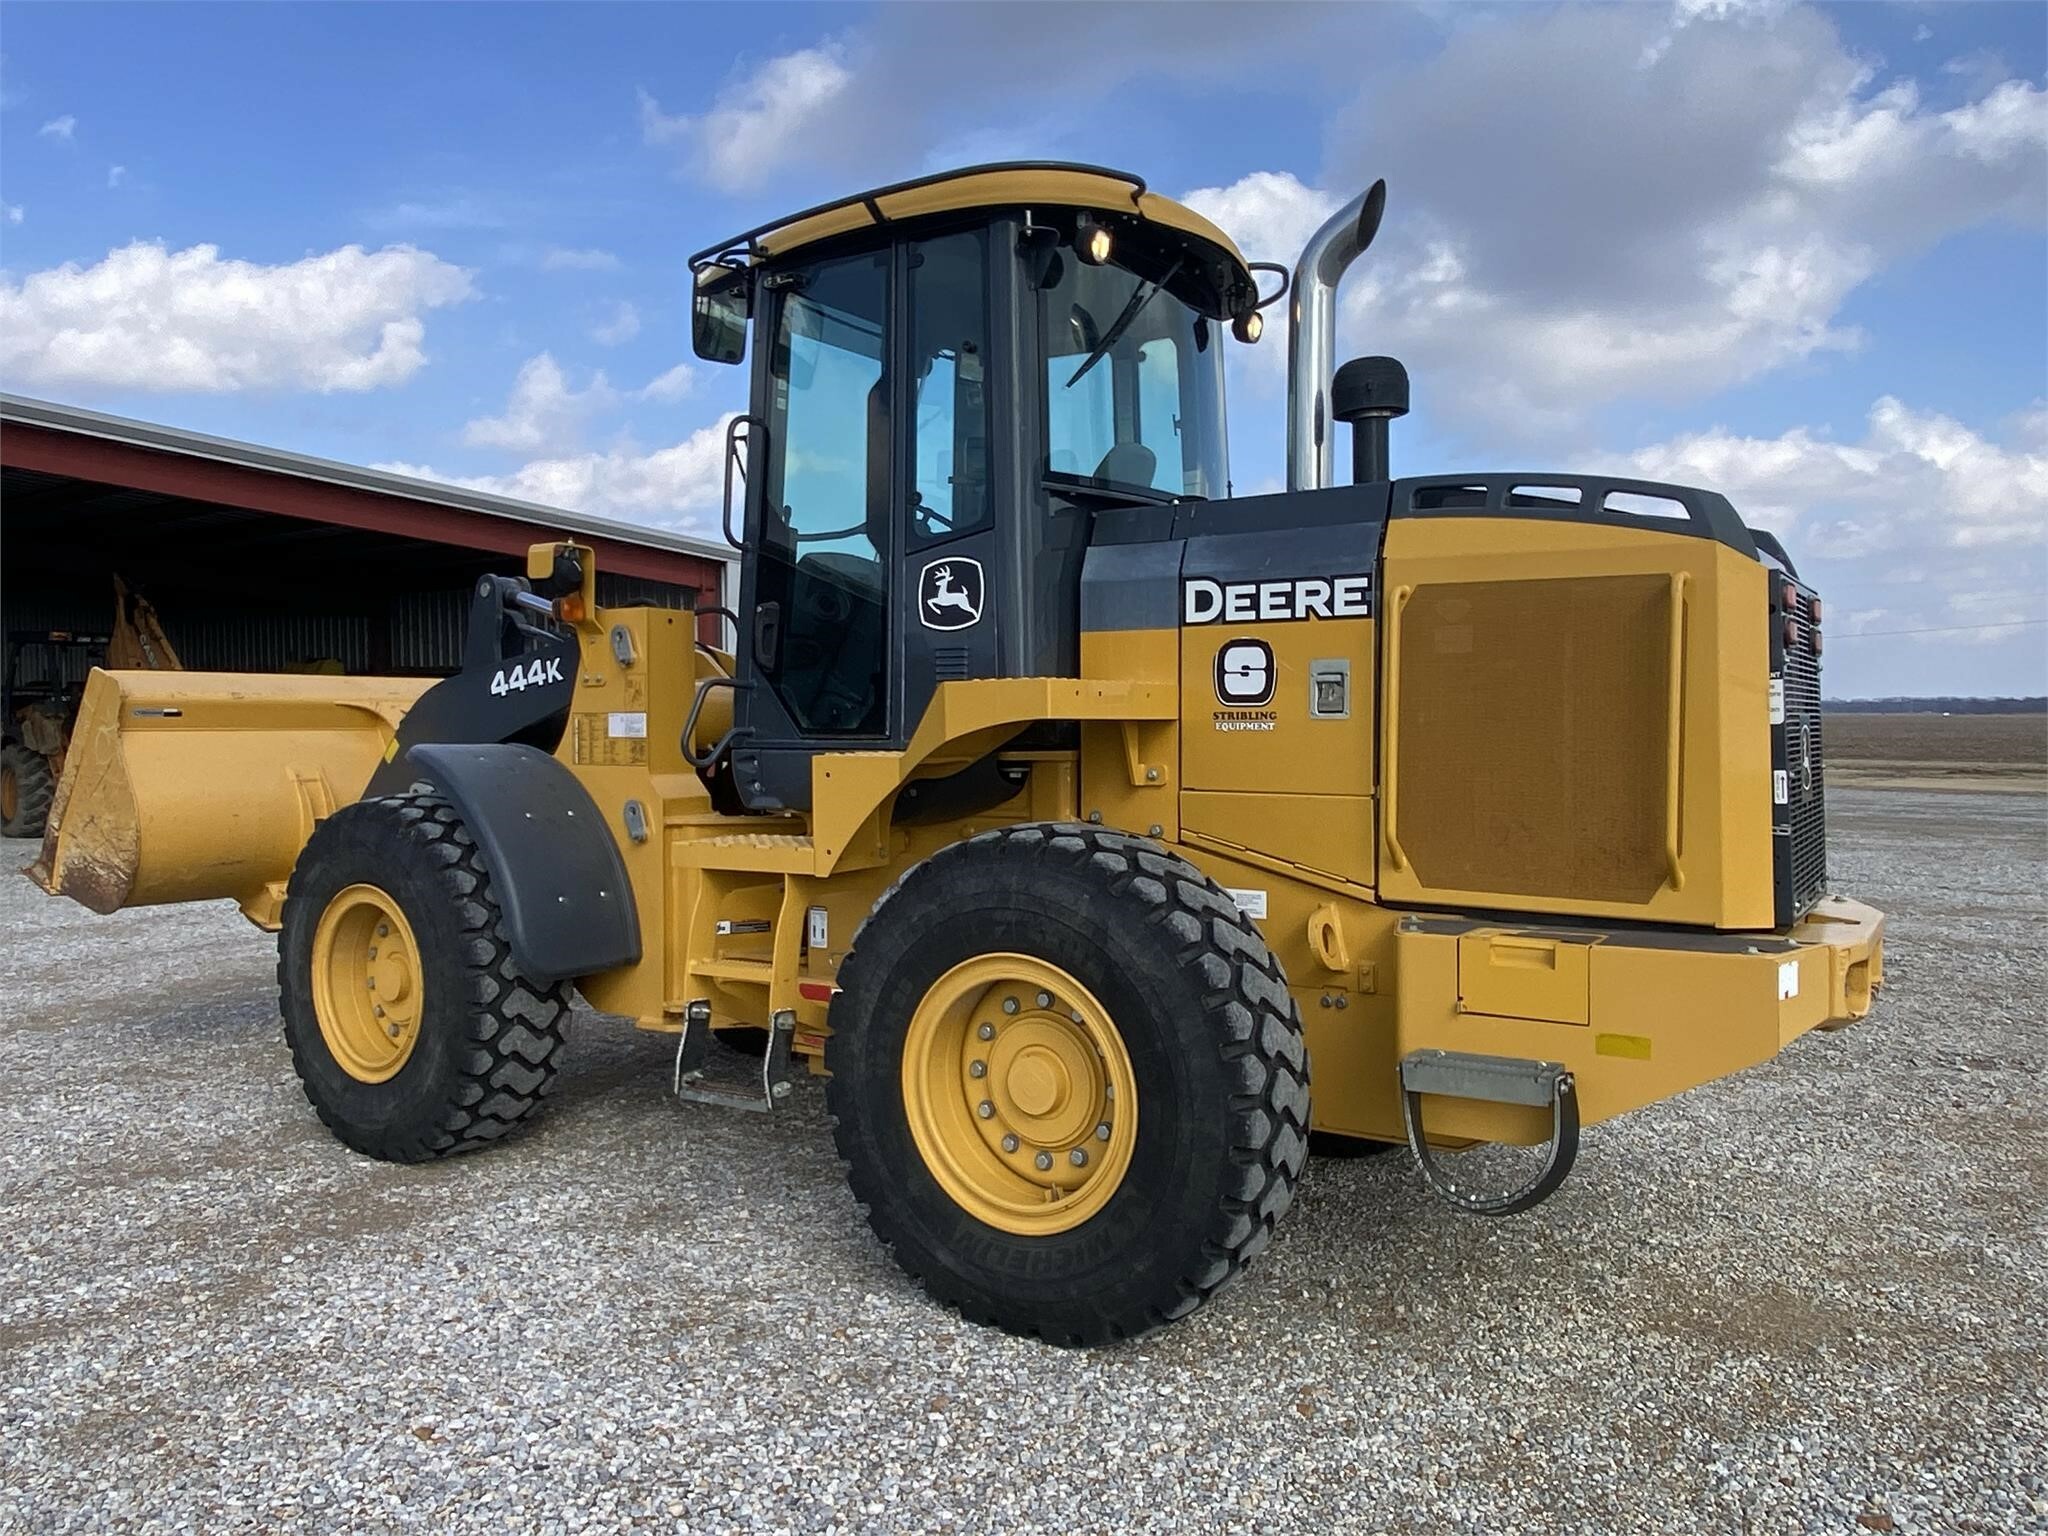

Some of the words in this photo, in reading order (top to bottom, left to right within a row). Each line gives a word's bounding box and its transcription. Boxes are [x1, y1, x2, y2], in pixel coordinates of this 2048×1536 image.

[1185, 577, 1368, 622] DEERE
[490, 657, 564, 696] 444K
[1212, 711, 1278, 721] STRIBLING
[1215, 722, 1276, 732] EQUIPMENT
